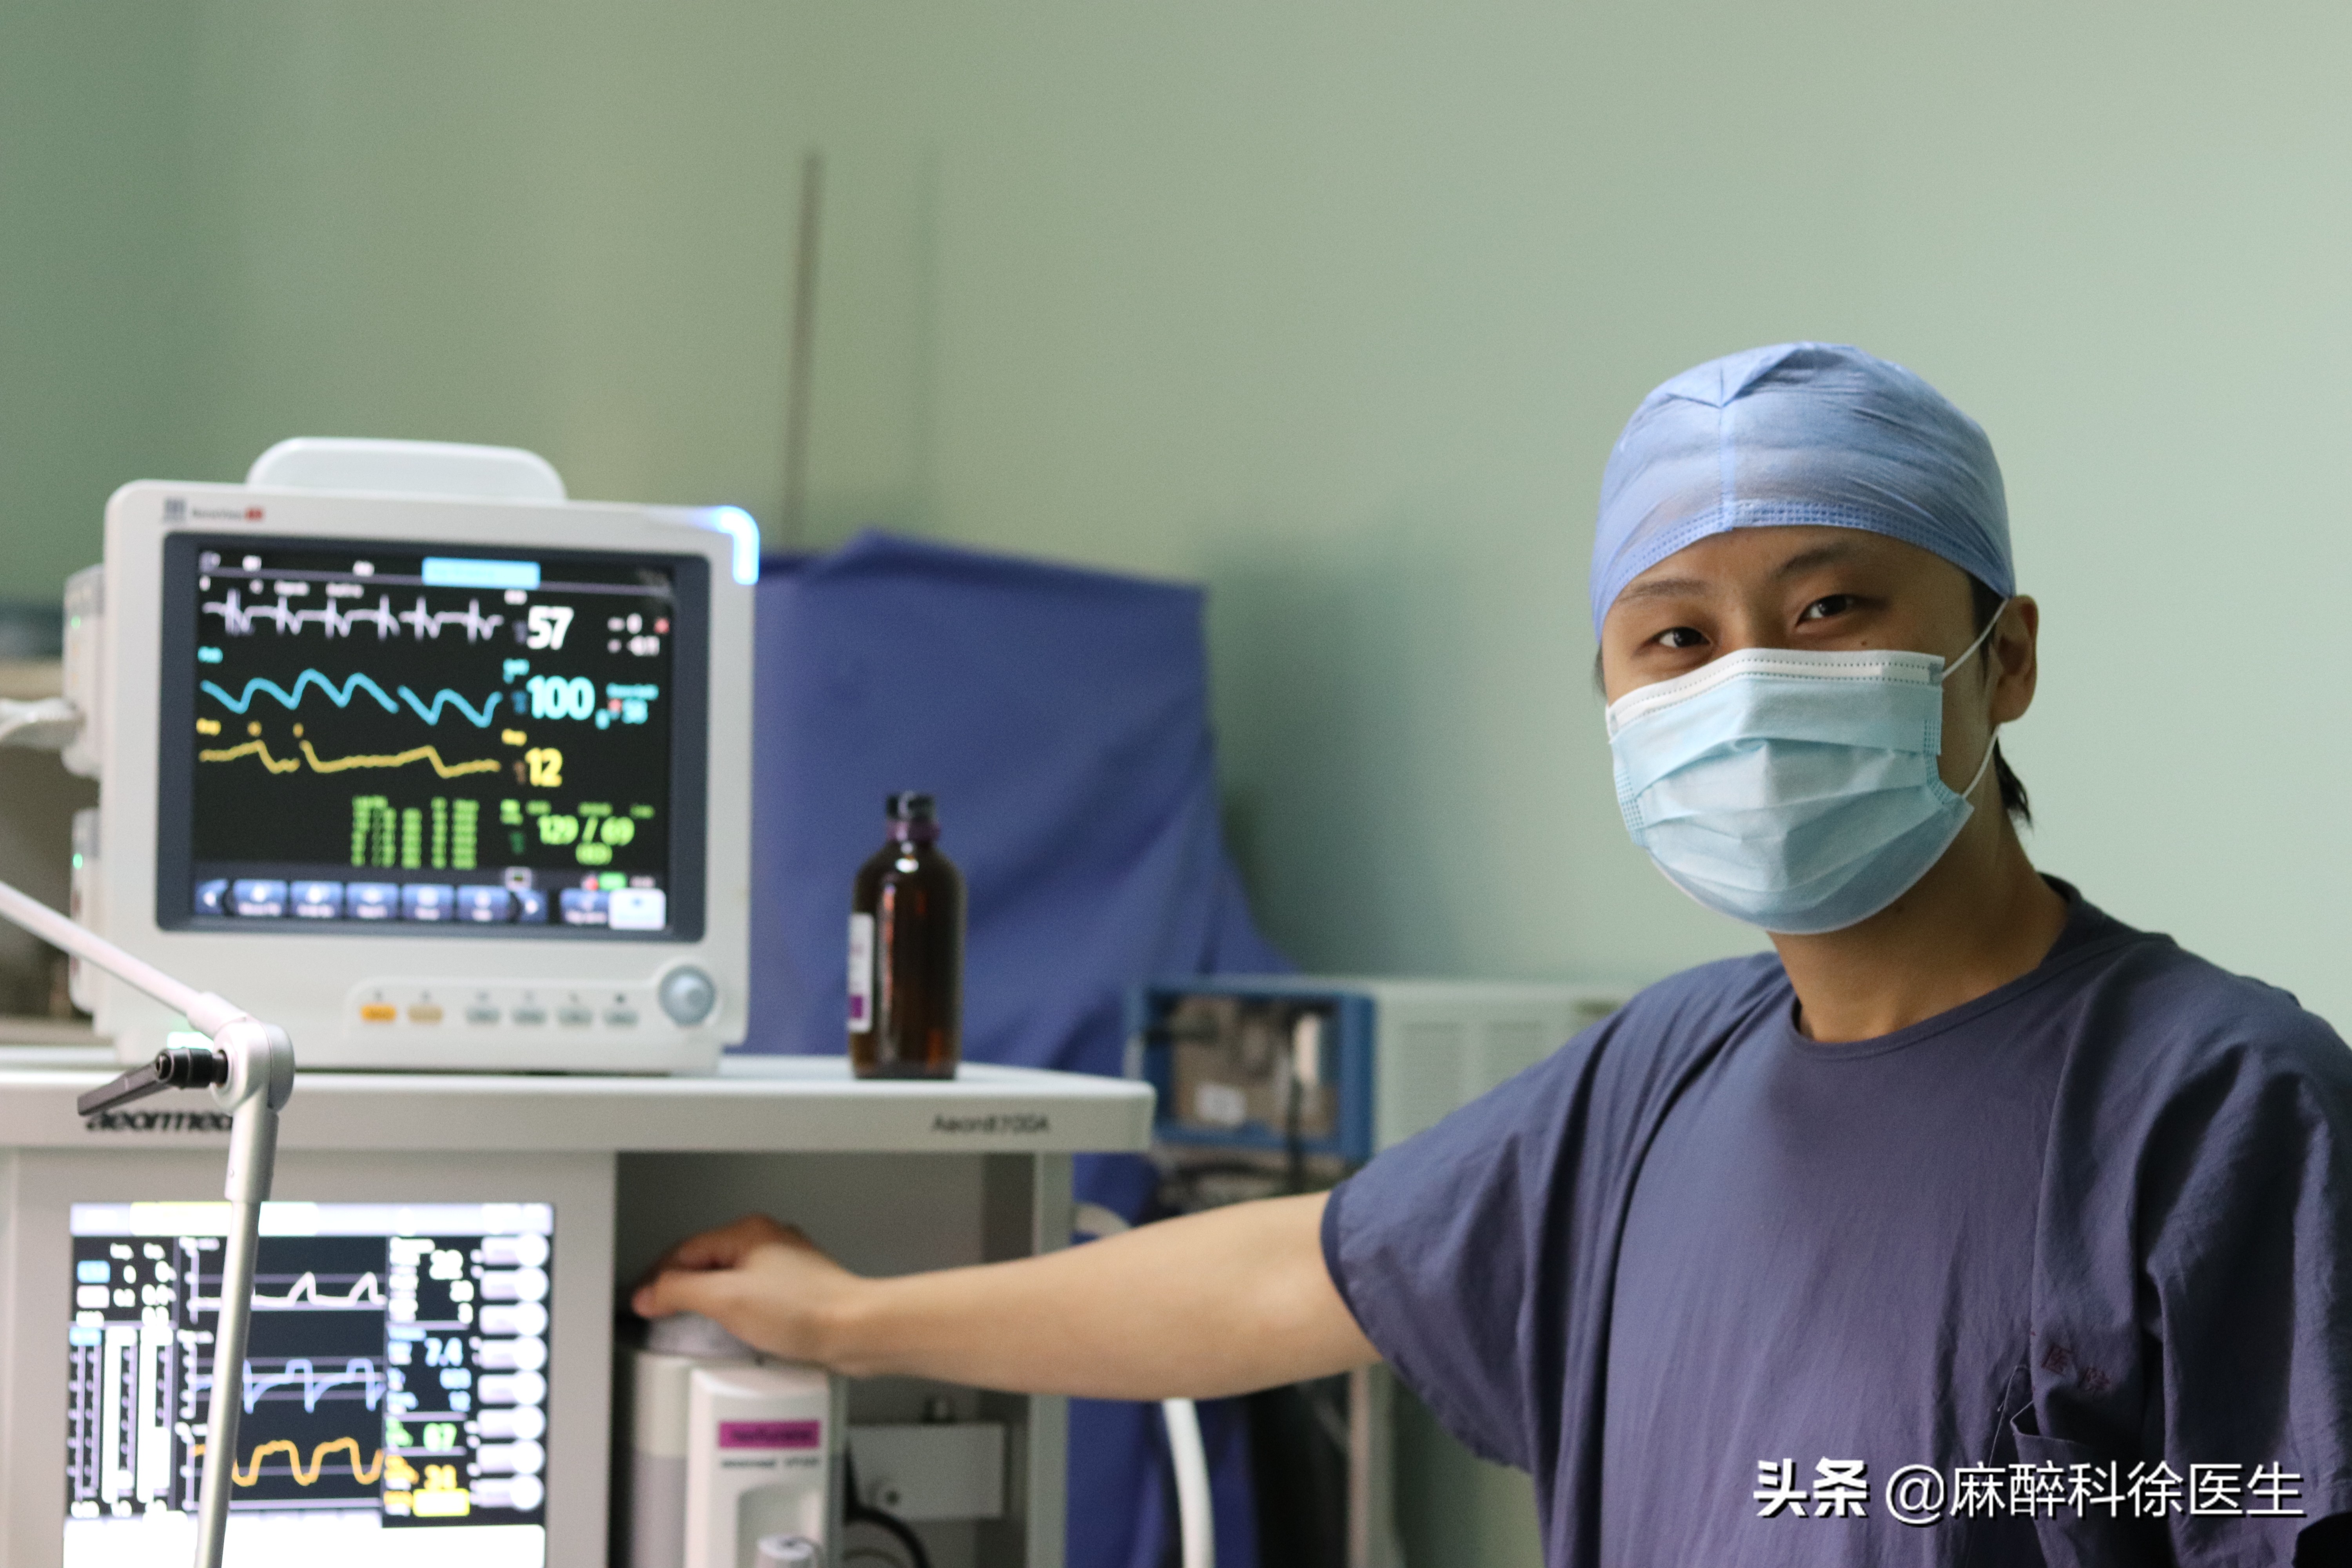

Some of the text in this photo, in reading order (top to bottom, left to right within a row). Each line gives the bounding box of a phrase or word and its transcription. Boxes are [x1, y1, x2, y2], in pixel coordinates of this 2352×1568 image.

[527, 605, 574, 650] 57
[526, 675, 595, 720] 100
[525, 747, 563, 787] 12
